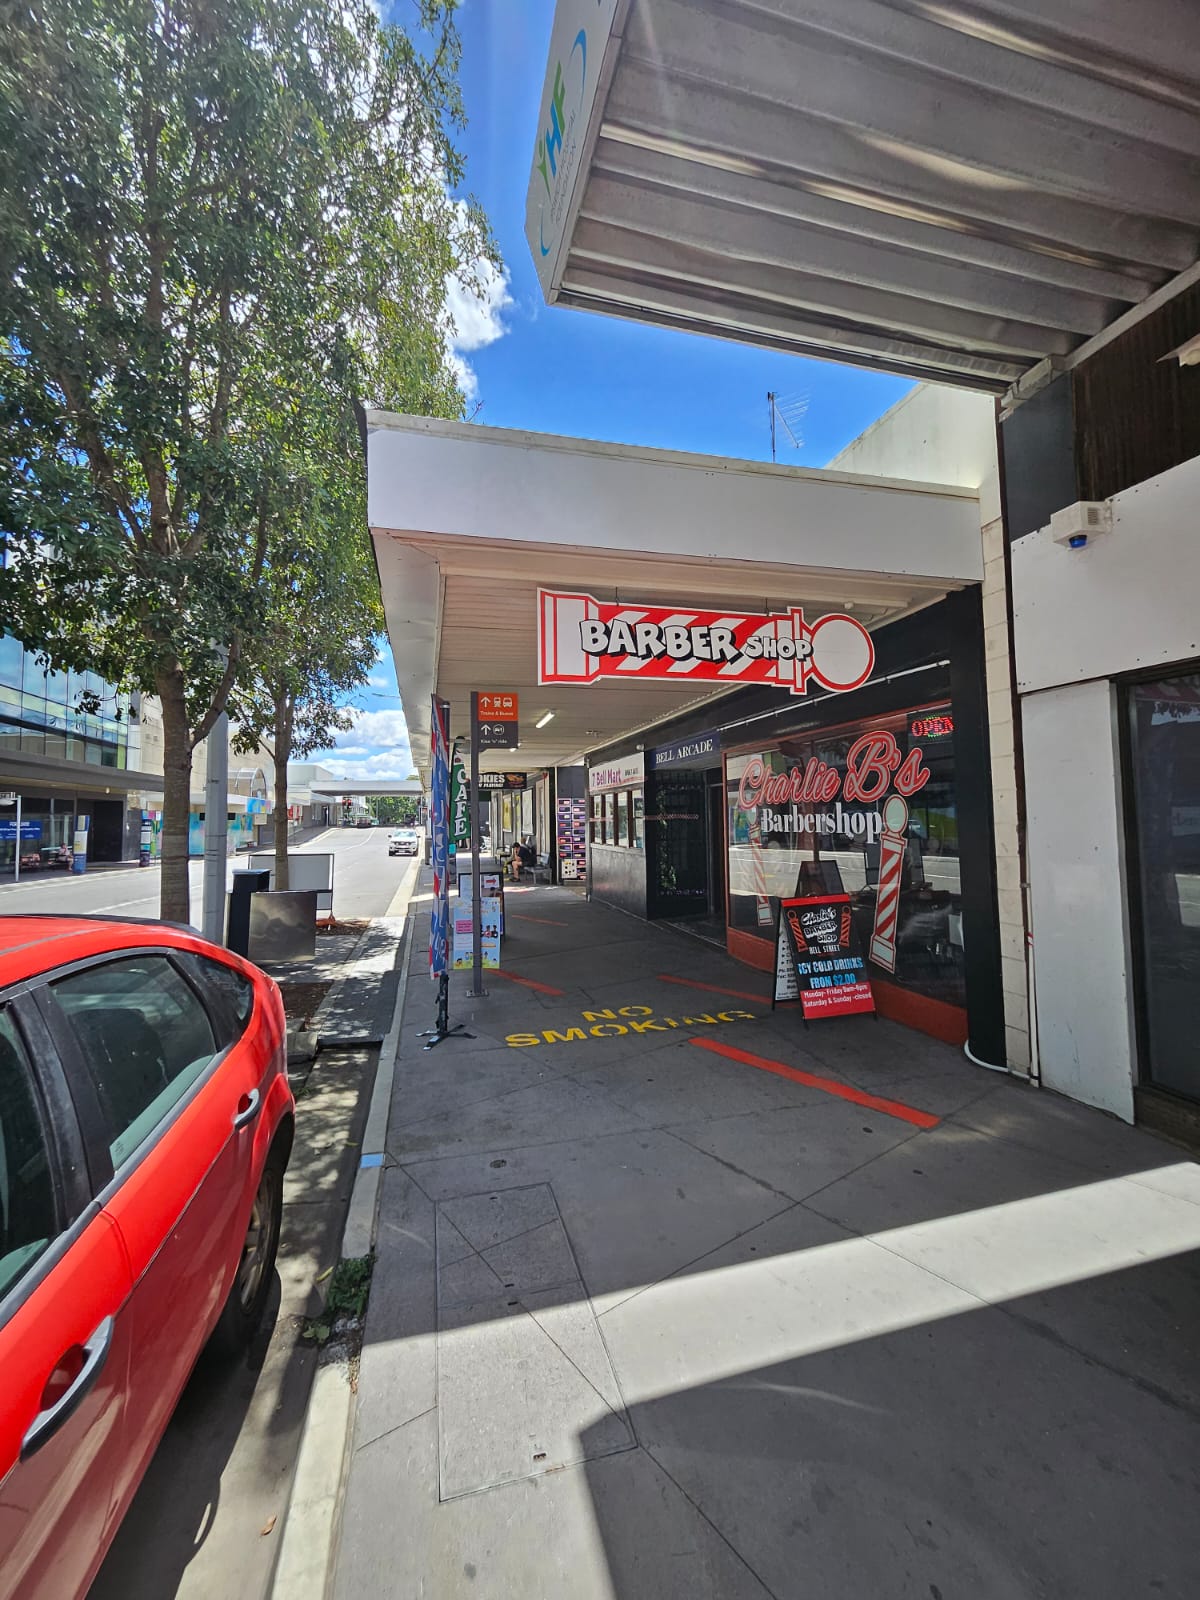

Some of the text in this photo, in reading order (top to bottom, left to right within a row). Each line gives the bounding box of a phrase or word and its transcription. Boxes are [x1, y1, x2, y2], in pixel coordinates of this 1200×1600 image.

[579, 618, 815, 665] BARBER SHOP
[911, 716, 954, 737] OPEN
[655, 739, 713, 764] BELL ARCADE
[478, 774, 506, 783] OKIES
[596, 771, 607, 785] Bell
[607, 767, 621, 784] Mart
[739, 730, 931, 810] Charlie B's
[454, 768, 468, 836] CAFE
[760, 801, 884, 844] Barbershop
[803, 920, 838, 939] BARBER
[817, 934, 838, 944] SHOP
[808, 945, 821, 955] BELL
[822, 944, 841, 953] STREET
[798, 957, 864, 975] ICY COLD DRINKS
[809, 973, 857, 990] FROM $2.00
[826, 988, 843, 997] Friday
[581, 1005, 654, 1022] NO
[504, 1010, 757, 1048] SMOKING
